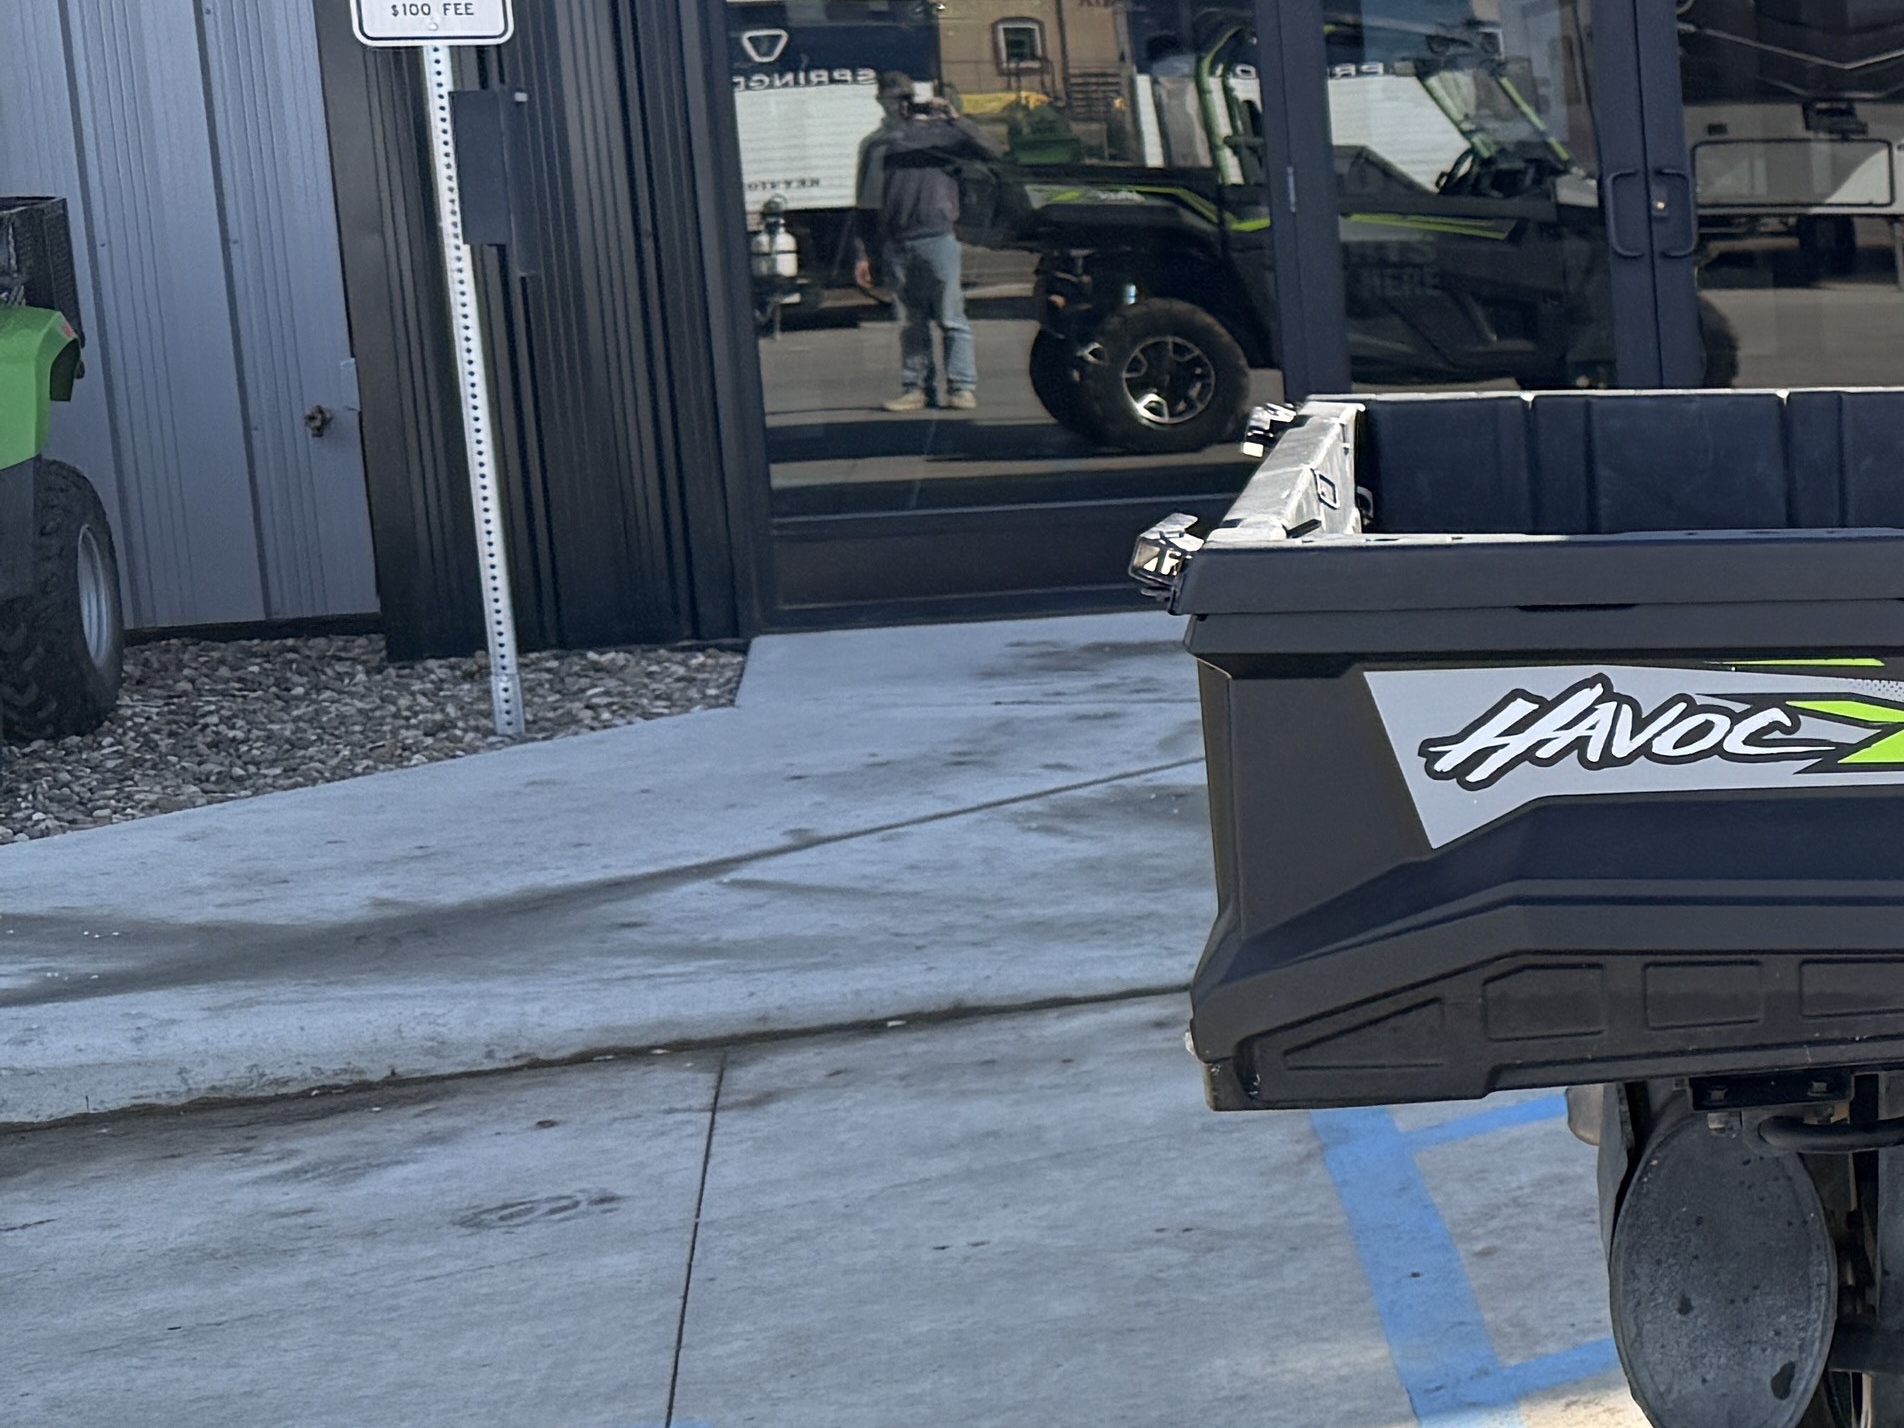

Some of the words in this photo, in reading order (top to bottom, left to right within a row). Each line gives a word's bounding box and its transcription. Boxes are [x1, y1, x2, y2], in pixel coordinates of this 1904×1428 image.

[390, 2, 431, 18] $100
[442, 2, 475, 17] FEE
[1424, 680, 1838, 786] HAVOC
